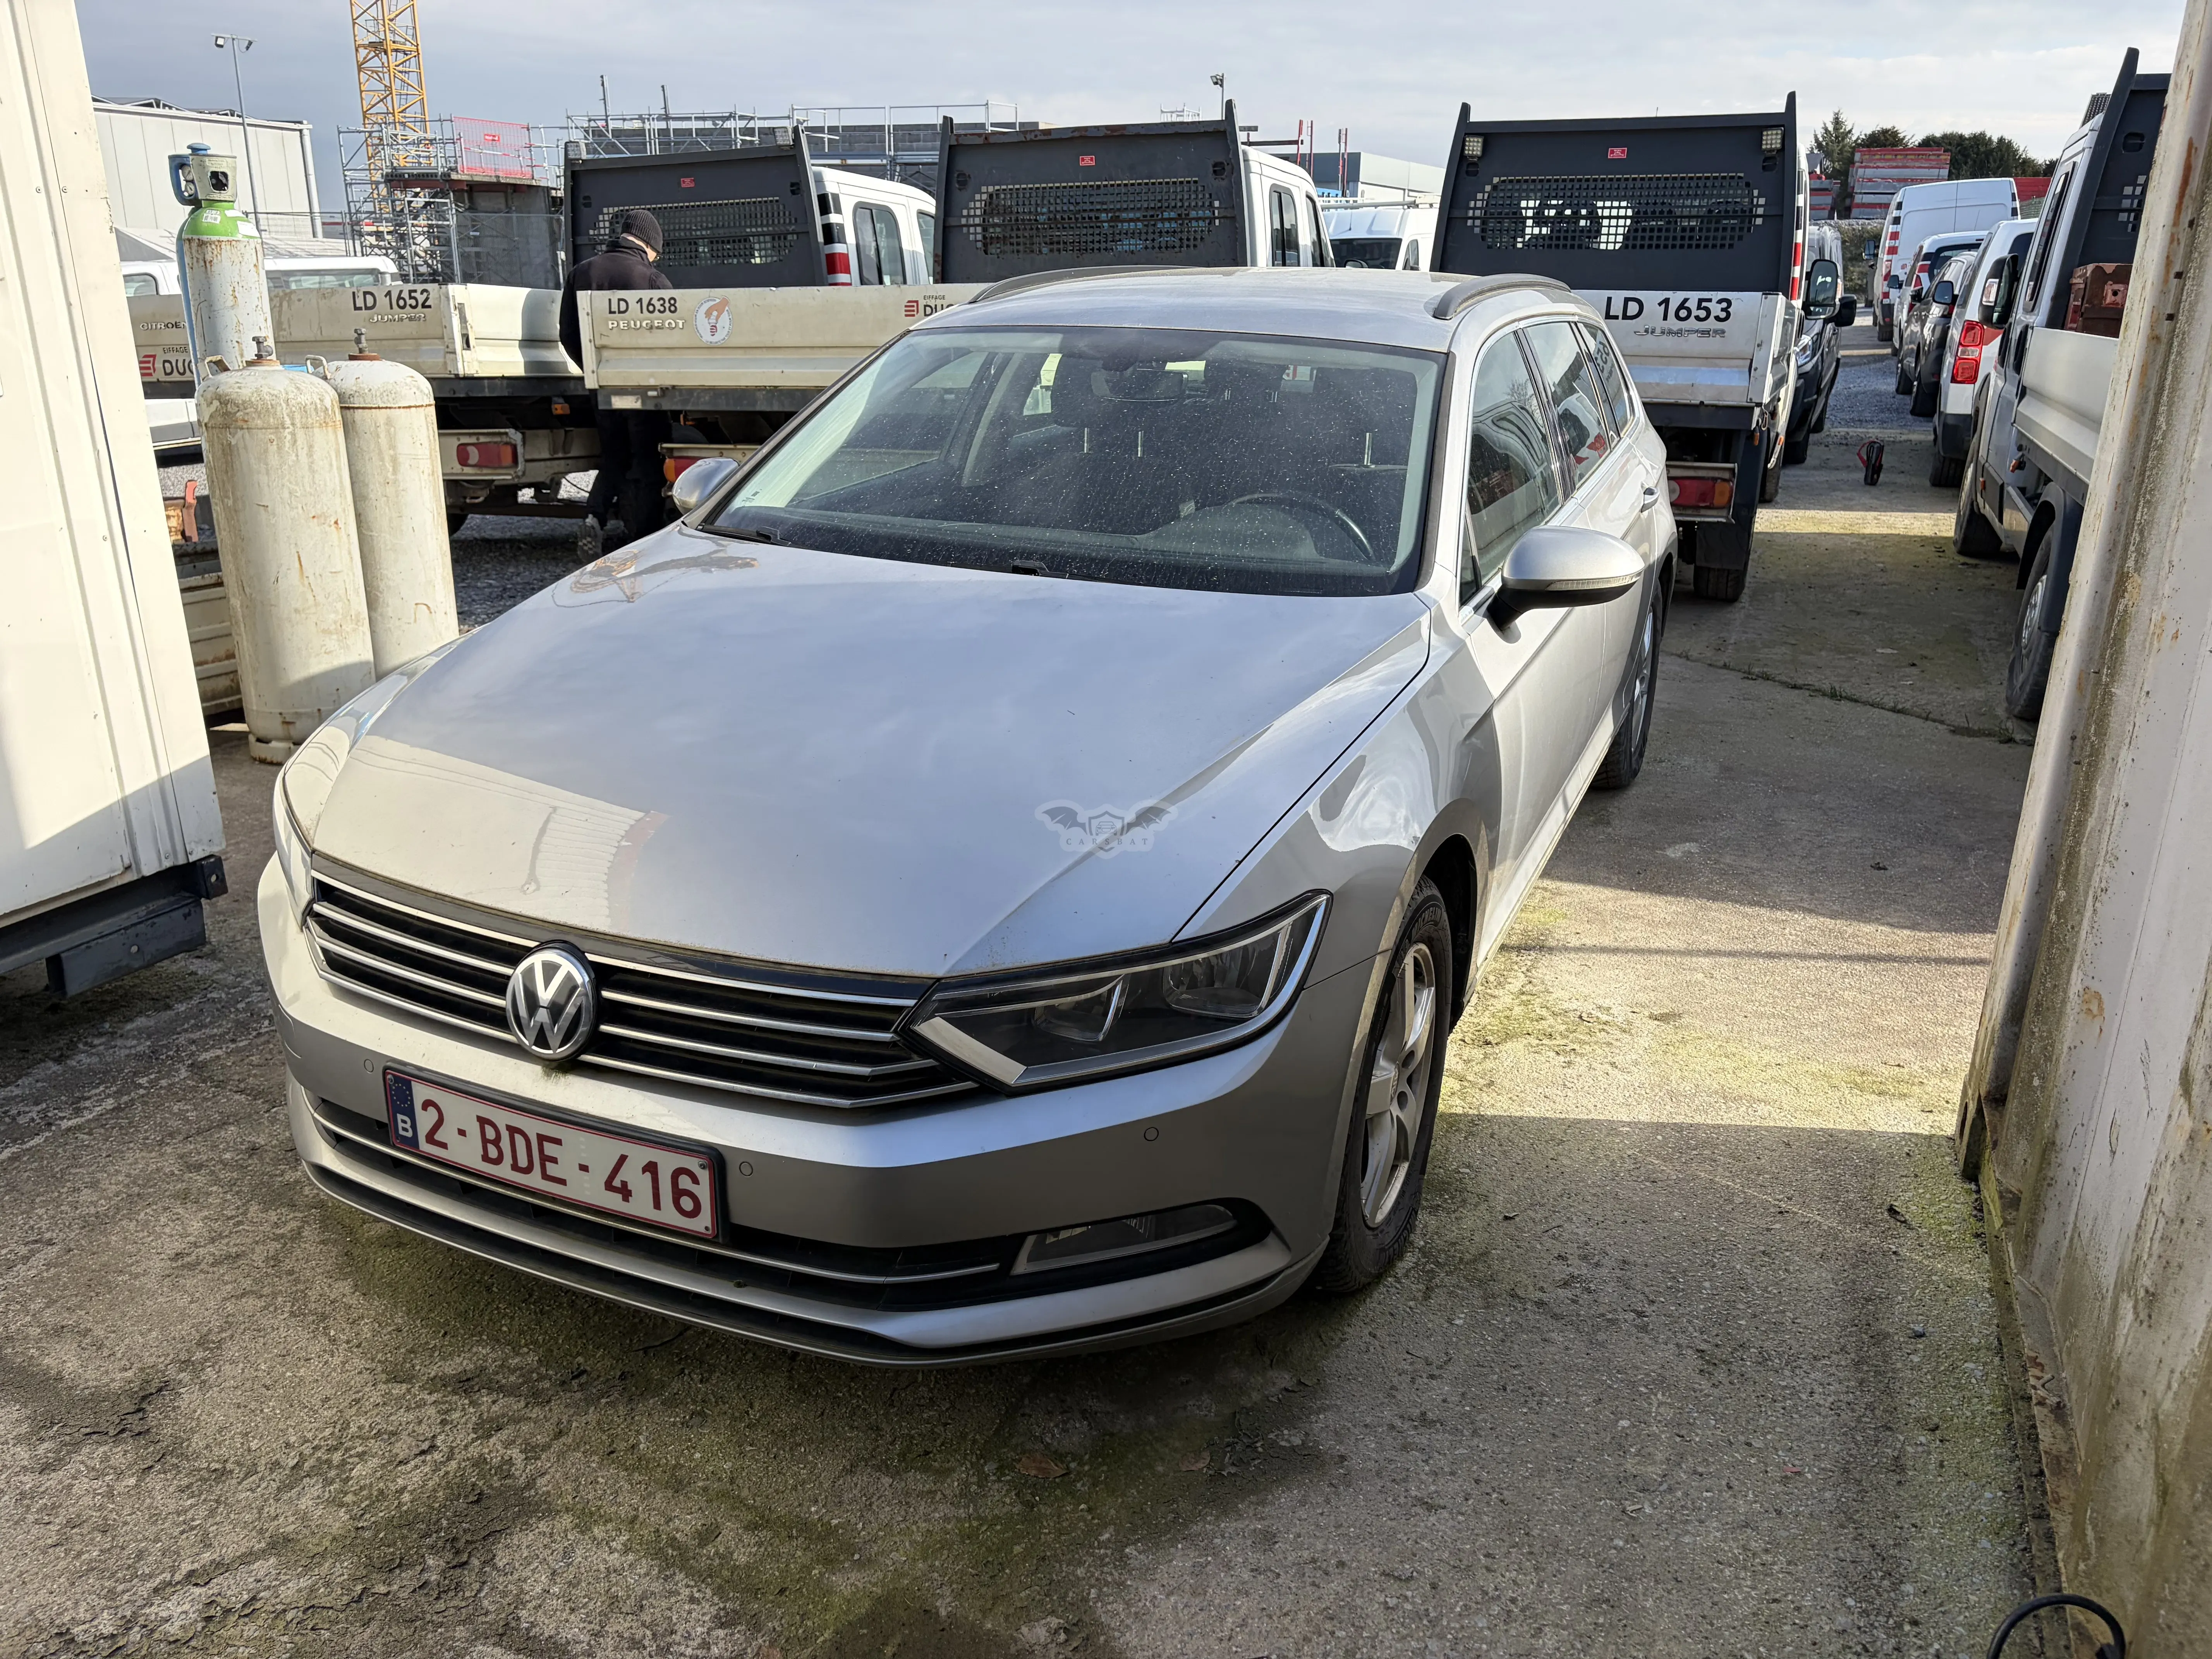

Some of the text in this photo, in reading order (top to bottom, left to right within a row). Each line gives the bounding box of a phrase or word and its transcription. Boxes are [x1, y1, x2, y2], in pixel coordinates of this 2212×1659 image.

[352, 288, 432, 311] LD 1652
[608, 297, 678, 314] LD 1638
[370, 313, 426, 323] JUMPER
[1604, 296, 1733, 323] LD 1653
[608, 319, 685, 330] PEUGEOT
[1633, 325, 1727, 338] JUMPER
[397, 1113, 413, 1138] B
